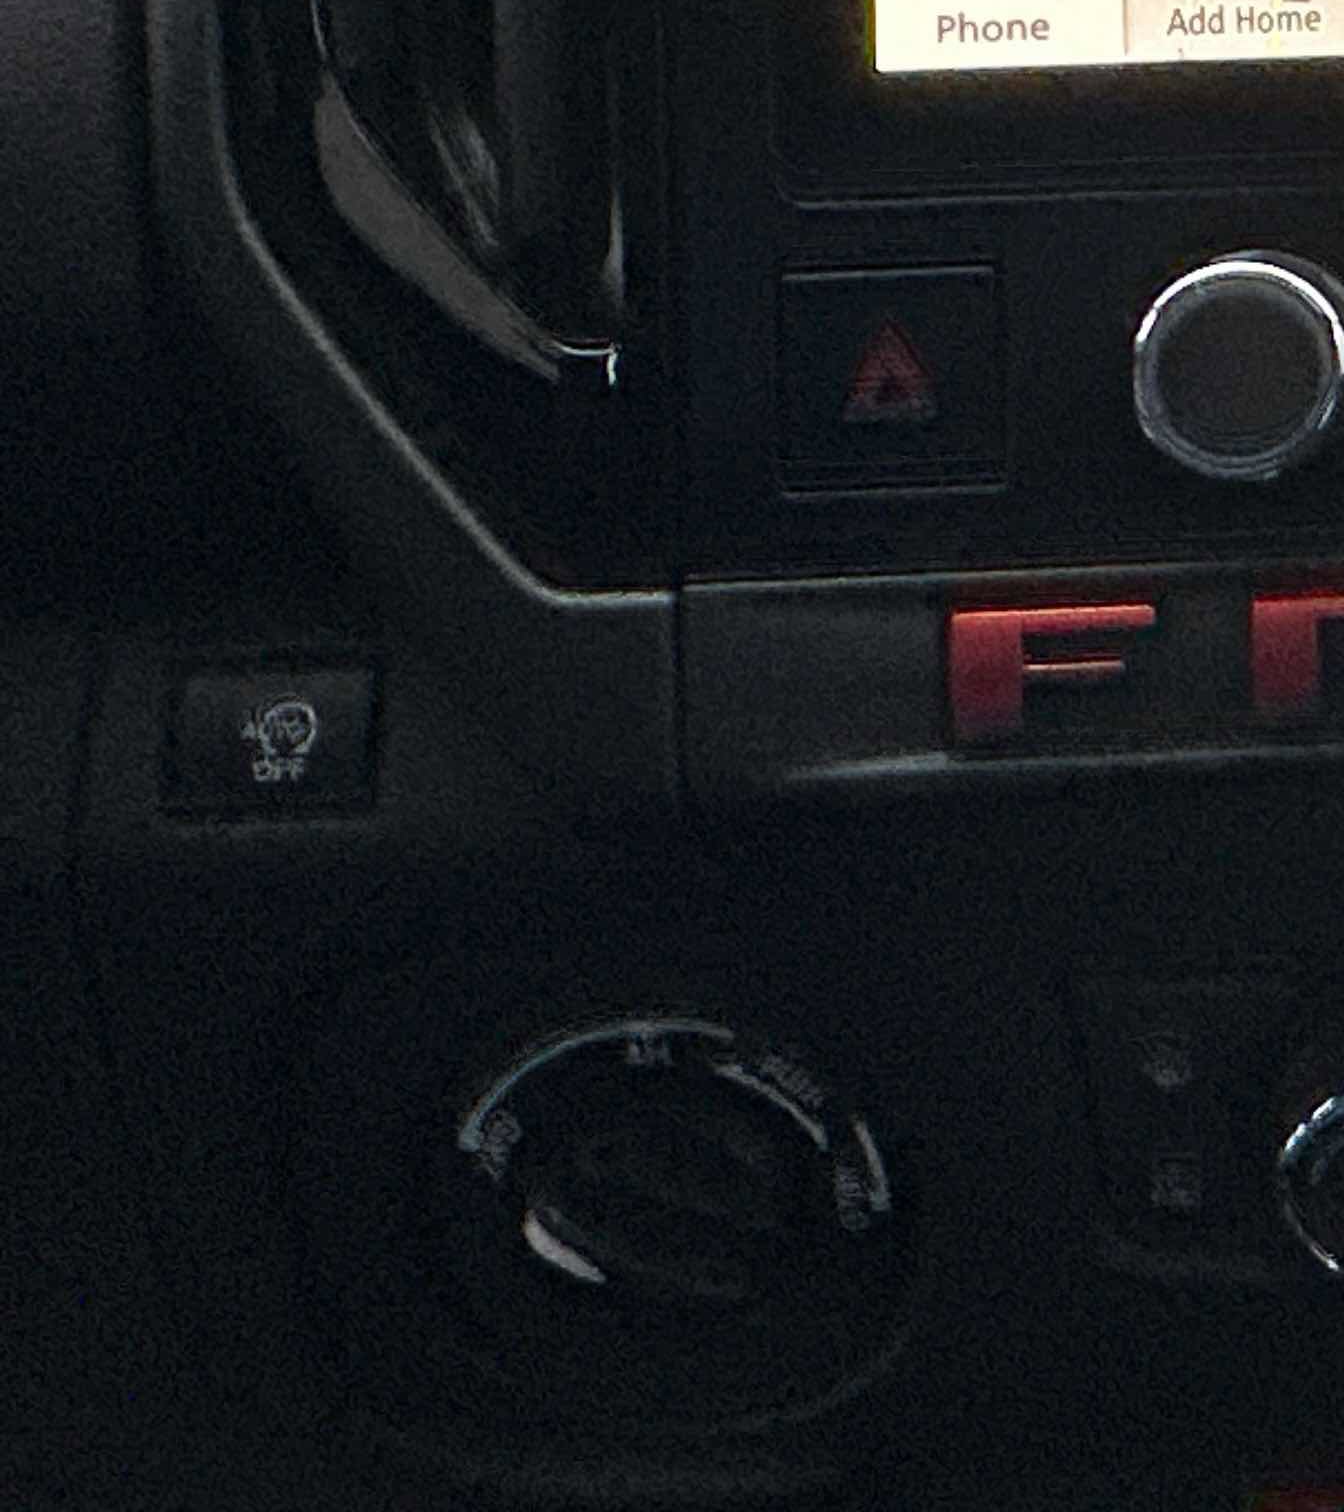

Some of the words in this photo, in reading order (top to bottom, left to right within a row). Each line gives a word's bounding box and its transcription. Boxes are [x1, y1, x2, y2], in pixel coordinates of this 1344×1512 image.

[937, 11, 1050, 43] Phone
[1166, 4, 1225, 35] Add
[1235, 5, 1321, 33] Home
